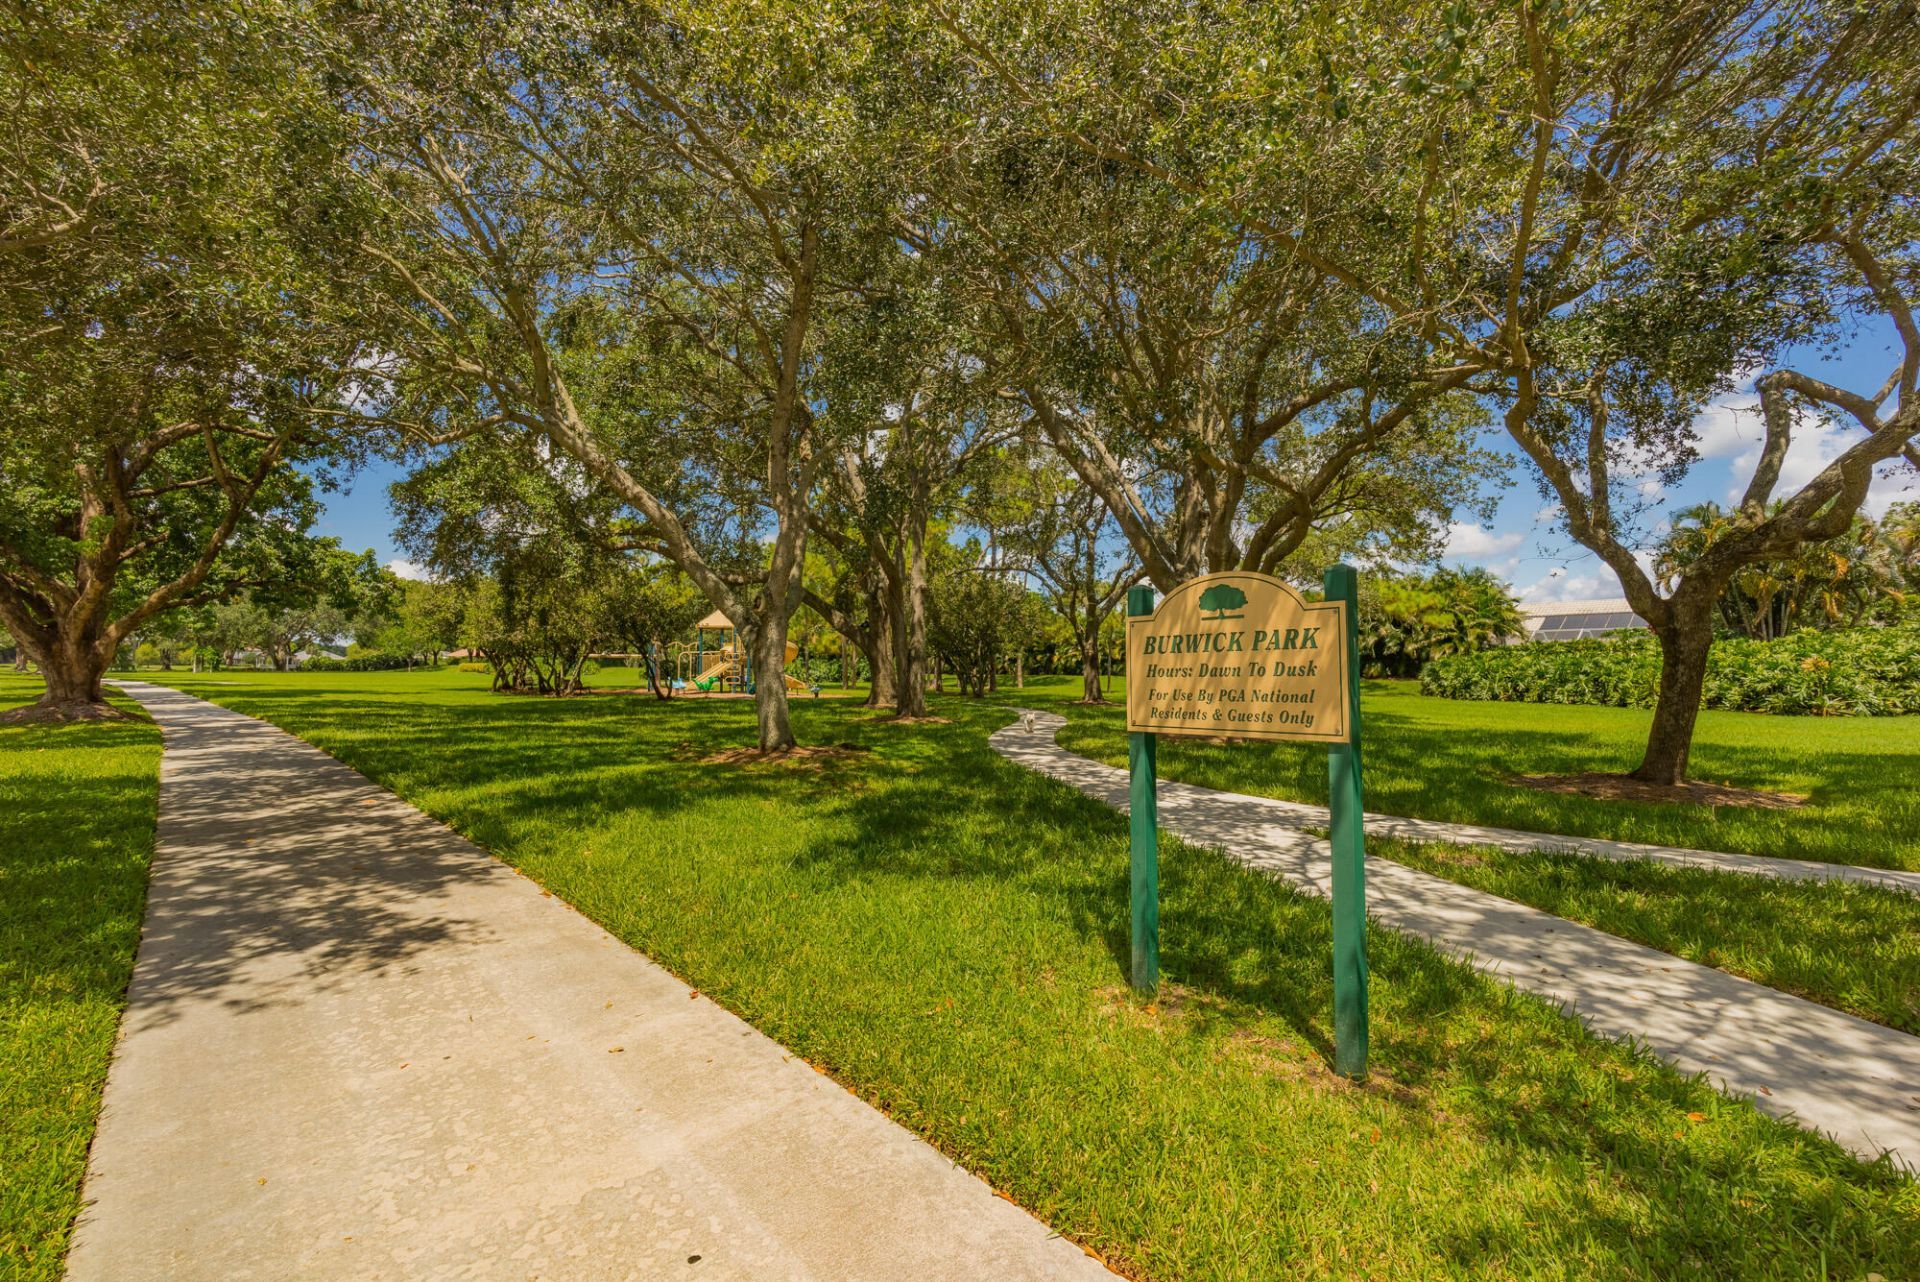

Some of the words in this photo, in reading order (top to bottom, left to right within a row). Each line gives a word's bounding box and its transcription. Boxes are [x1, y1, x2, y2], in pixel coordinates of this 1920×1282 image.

[1143, 632, 1245, 655] BURWICK
[1251, 627, 1320, 651] PARK
[1146, 664, 1192, 678] Hours:
[1199, 664, 1241, 677] Dawn
[1248, 662, 1266, 677] To
[1273, 661, 1317, 677] Dusk
[1148, 689, 1168, 701] For
[1173, 689, 1192, 701] Use
[1198, 690, 1213, 704] By
[1218, 689, 1245, 702] PGA
[1251, 690, 1314, 703] National
[1151, 708, 1207, 720] Residents
[1212, 709, 1222, 721] &
[1228, 709, 1273, 723] Guests
[1279, 711, 1314, 727] Only
